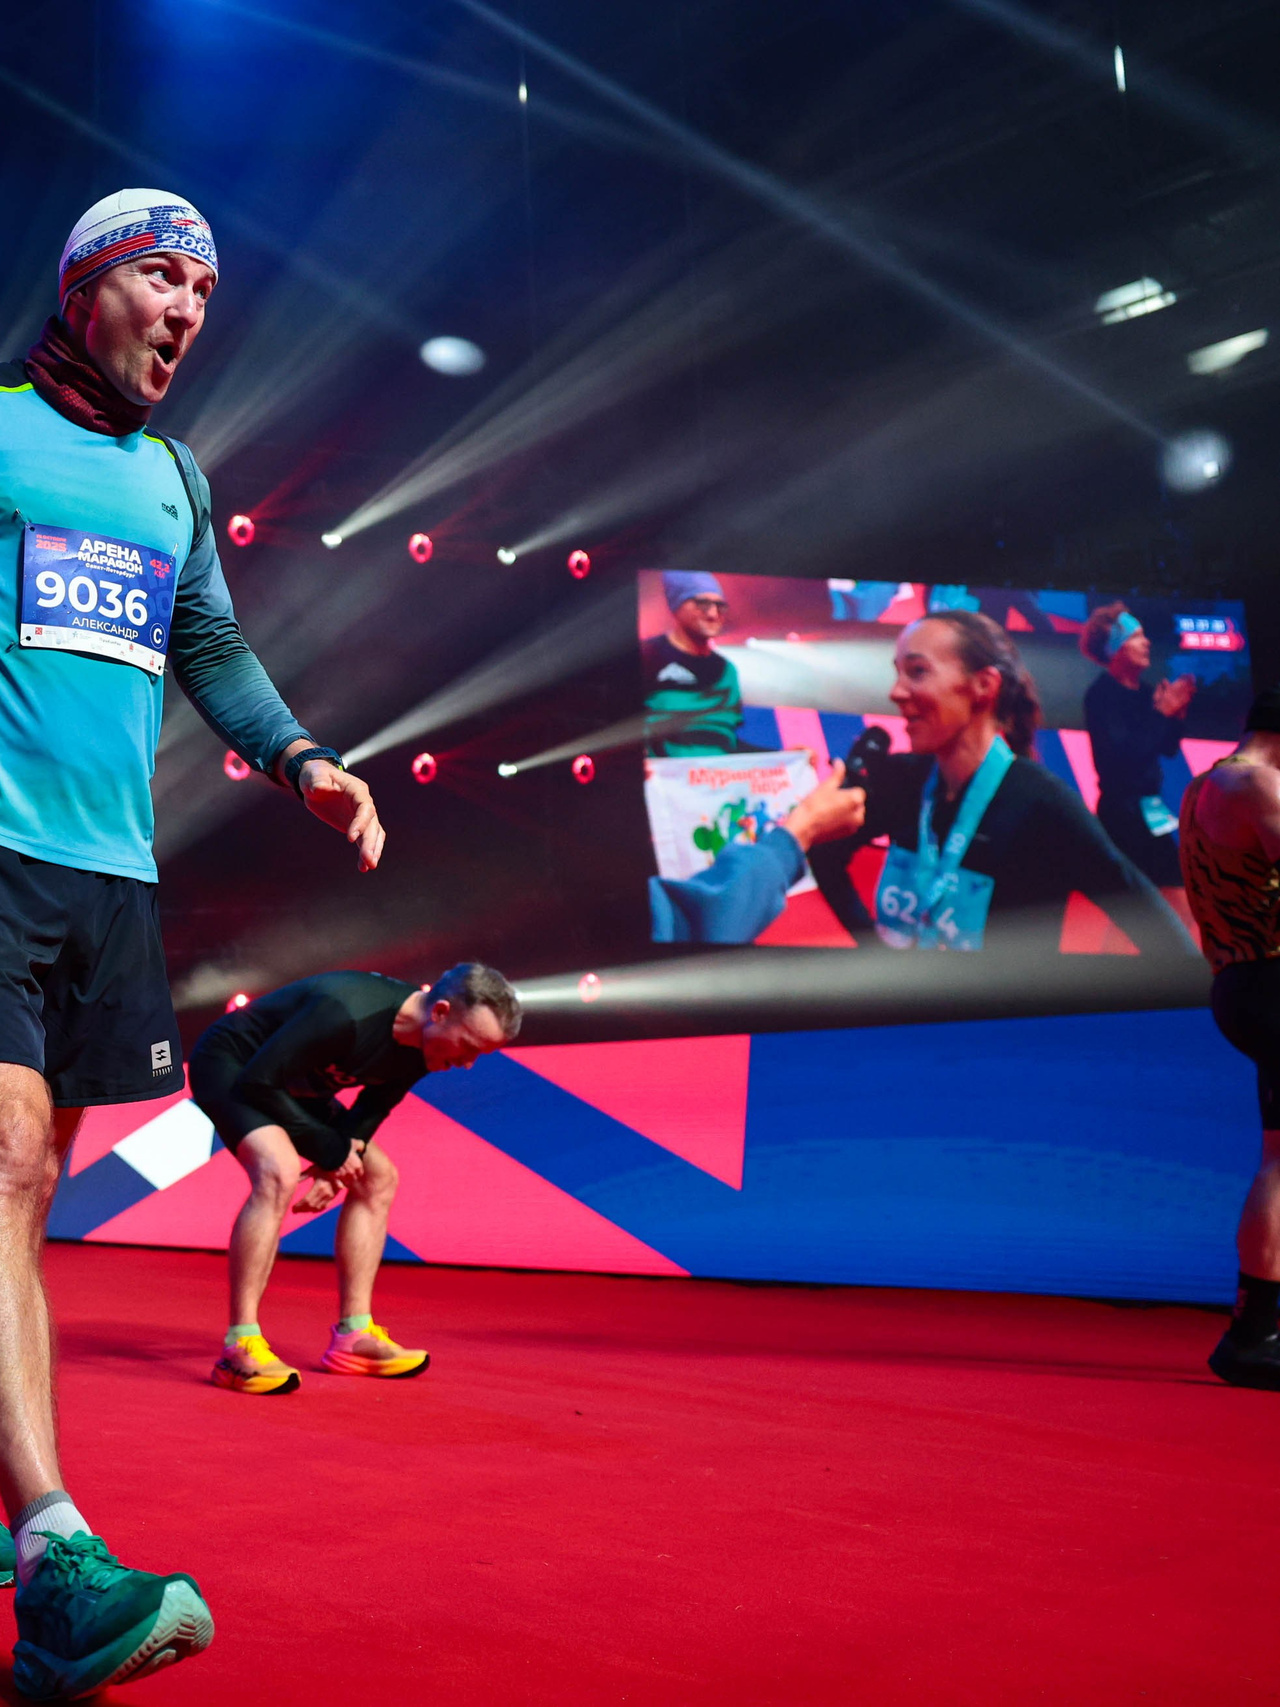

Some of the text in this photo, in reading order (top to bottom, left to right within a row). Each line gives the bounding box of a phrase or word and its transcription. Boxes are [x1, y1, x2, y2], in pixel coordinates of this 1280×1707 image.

[35, 540, 67, 552] 2025
[79, 538, 142, 565] АРЕНА
[77, 551, 144, 575] МАРАФОН
[85, 562, 136, 579] Санкт-Петербург
[35, 570, 149, 627] 9036
[72, 616, 140, 641] АЛЕКСАНДР
